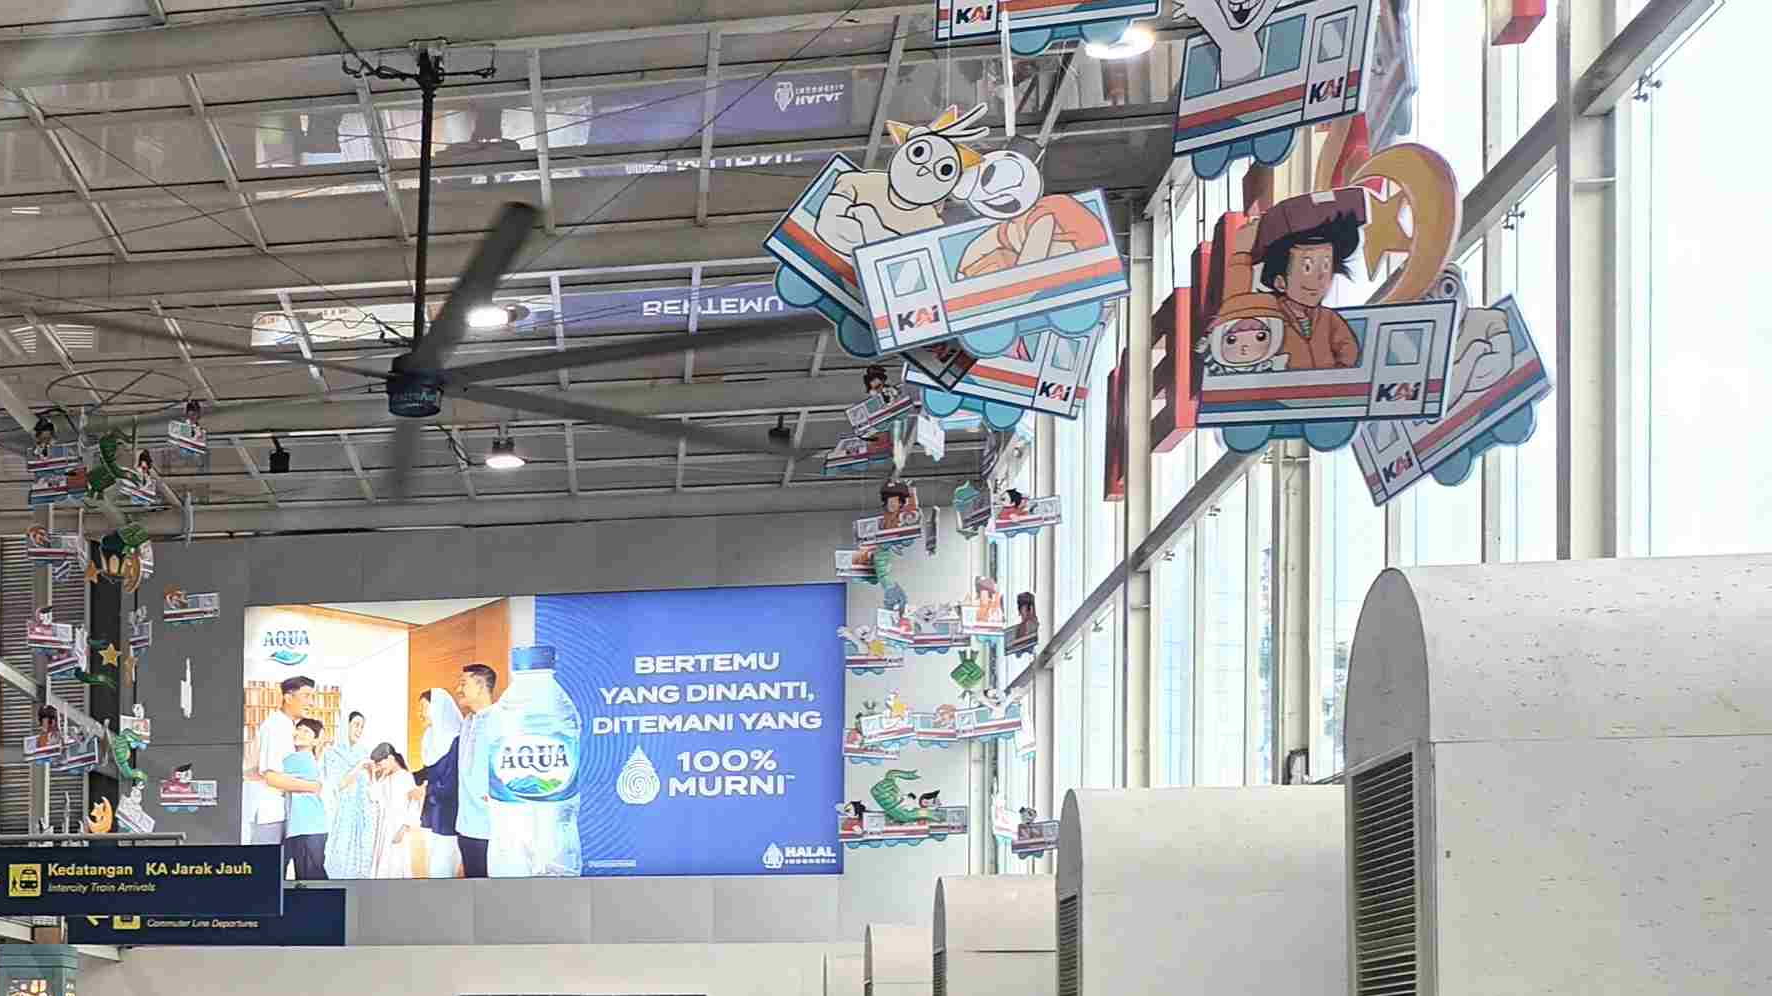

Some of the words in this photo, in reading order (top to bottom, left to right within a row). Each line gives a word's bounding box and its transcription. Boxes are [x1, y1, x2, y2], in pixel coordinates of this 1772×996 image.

[262, 630, 310, 649] AQUA
[634, 652, 780, 674] BERTEMU
[599, 684, 679, 705] YANG
[686, 681, 814, 702] DINANTI,
[592, 713, 733, 735] DITEMANI
[739, 710, 822, 731] YANG
[500, 744, 569, 773] AQUA
[677, 749, 777, 772] 100%
[784, 846, 837, 857] HALAL
[47, 863, 133, 878] Kedatangan
[145, 862, 169, 876] KA
[172, 862, 213, 875] Jarak
[216, 862, 252, 875] Jauh
